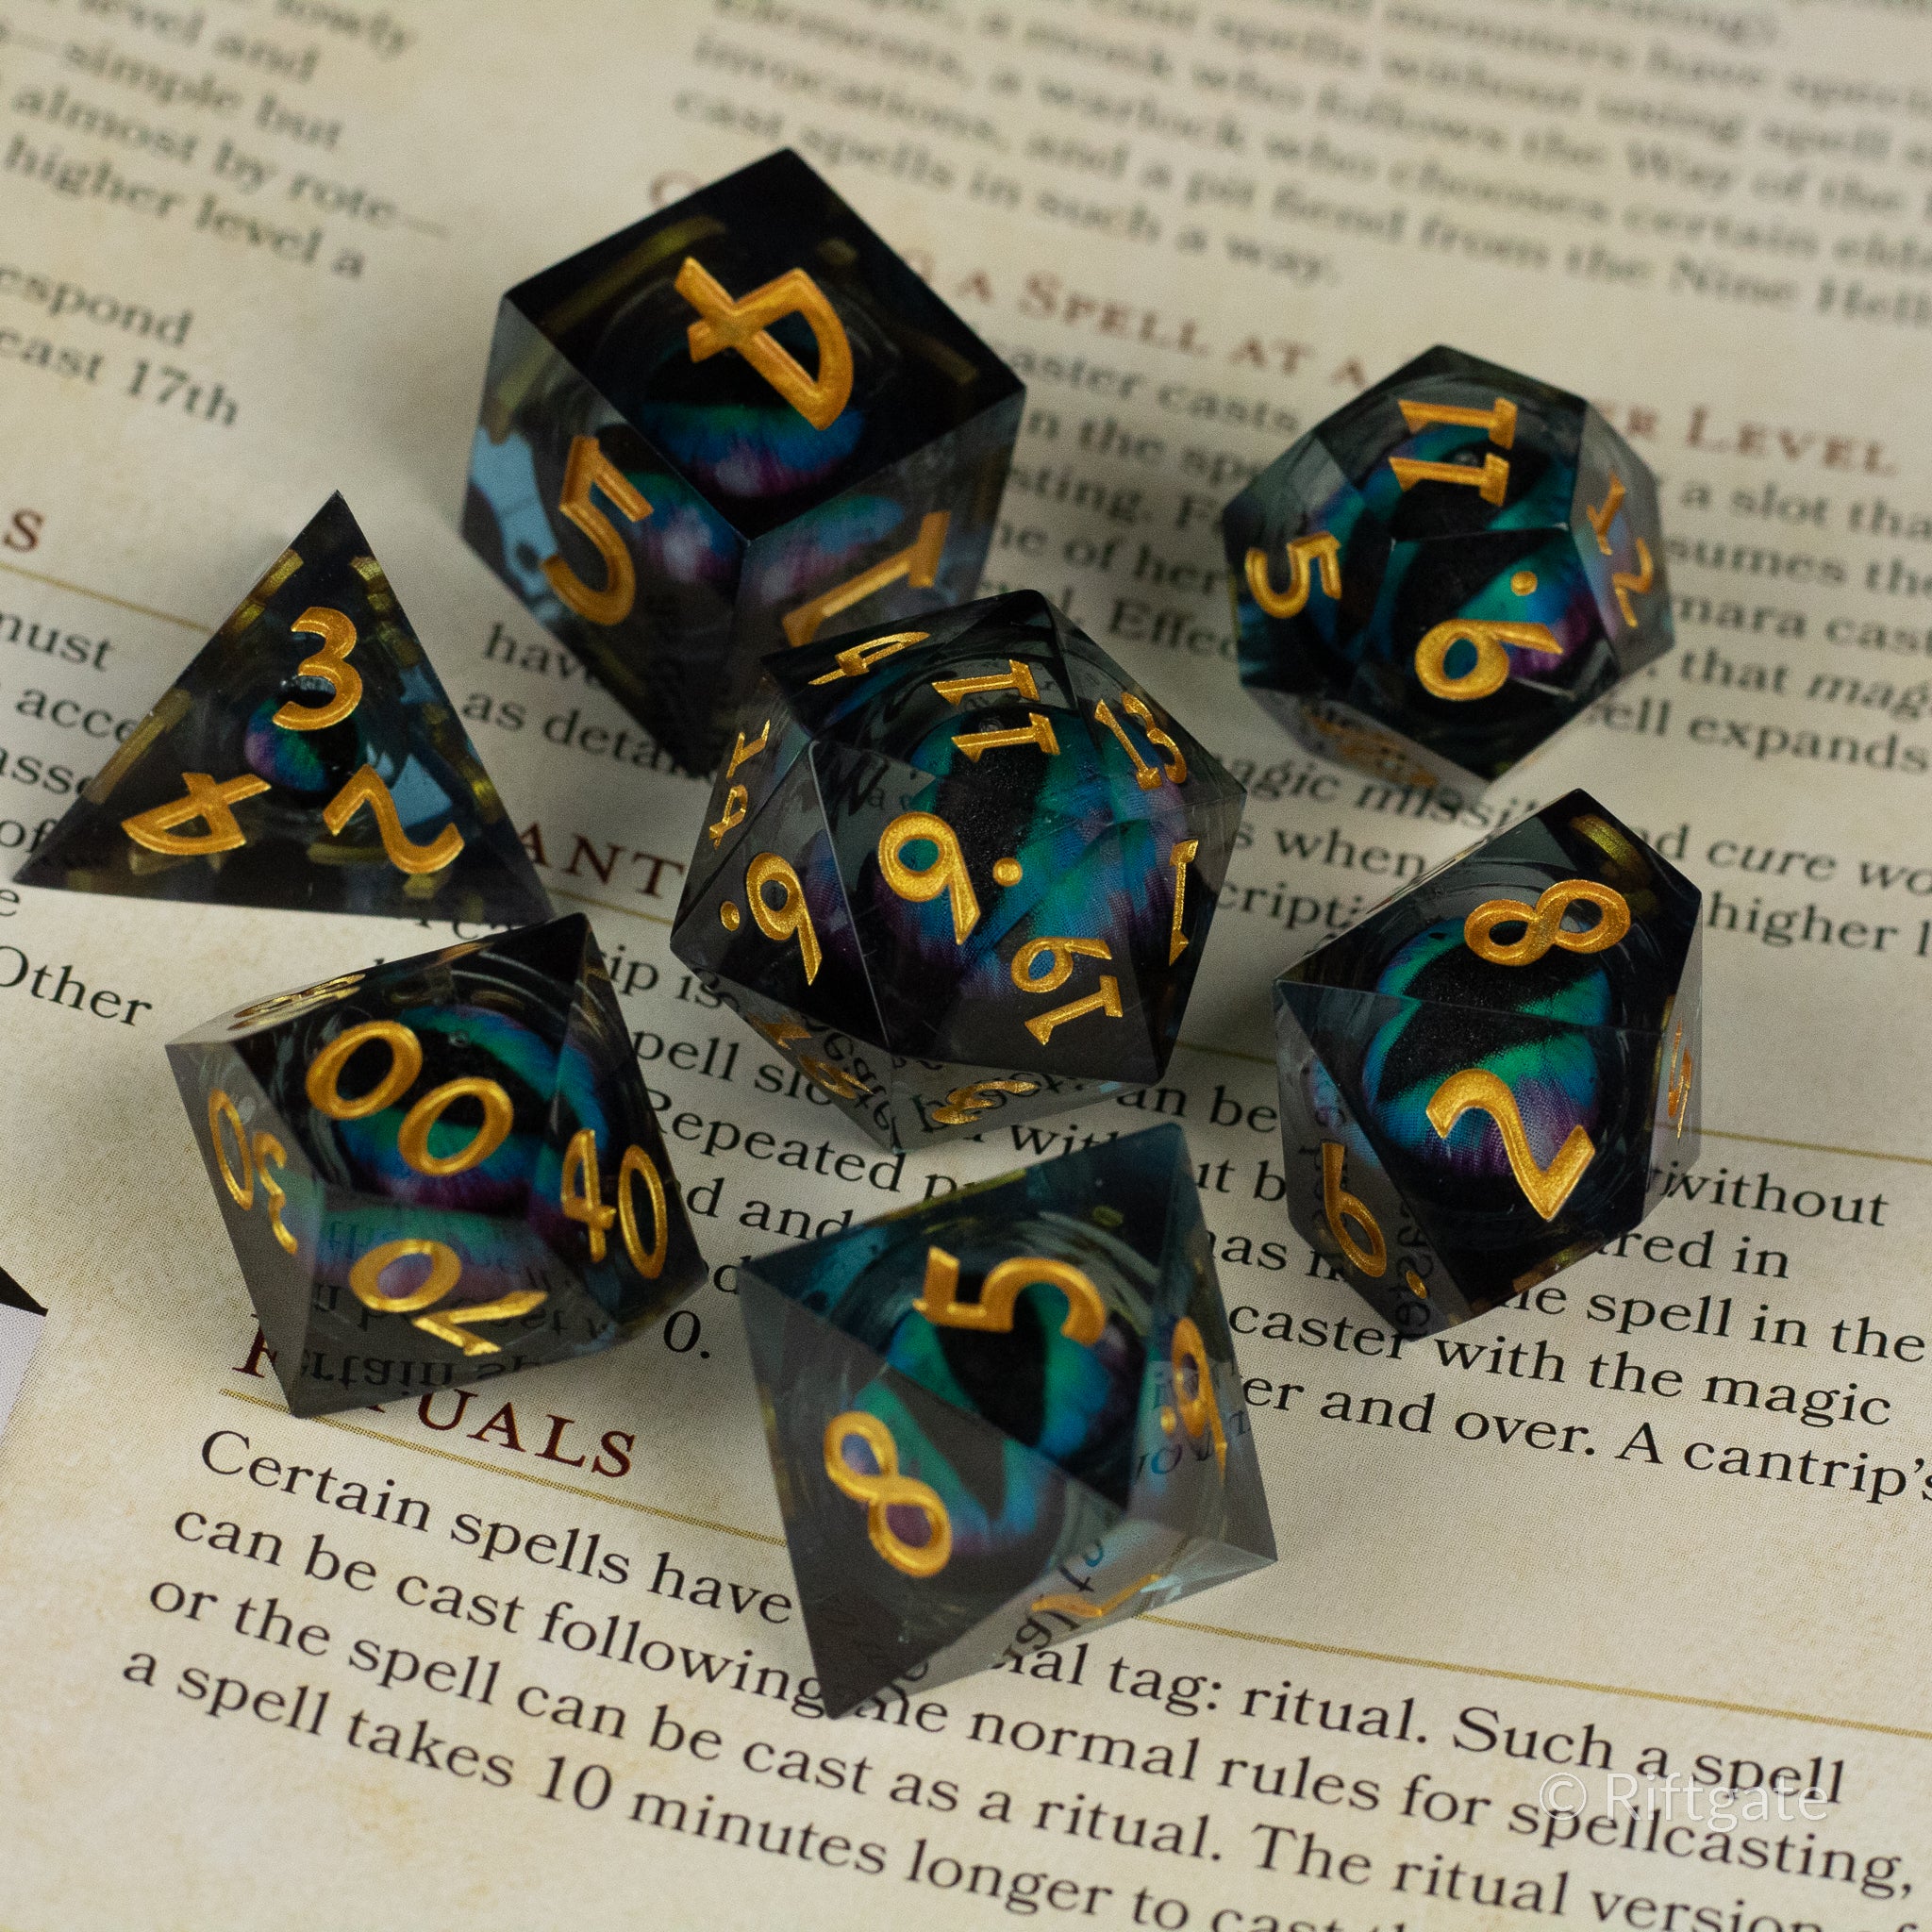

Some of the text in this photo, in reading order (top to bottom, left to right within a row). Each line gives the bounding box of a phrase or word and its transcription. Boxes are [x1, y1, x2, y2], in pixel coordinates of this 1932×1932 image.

[127, 358, 239, 427] 17th
[673, 255, 855, 432] 4
[1011, 351, 1149, 402] aster
[1388, 395, 1518, 508] 11
[538, 434, 655, 626] 5
[1665, 536, 1846, 585] sumes
[1847, 498, 1932, 542] tha
[780, 509, 952, 649] 1
[1243, 530, 1342, 619] 5
[272, 606, 363, 731] 3
[931, 658, 1061, 763] 11
[1805, 671, 1932, 724] mag
[1093, 691, 1188, 791] 13
[1236, 758, 1340, 804] agic
[121, 771, 273, 856] 4
[323, 763, 466, 874] 2
[1463, 878, 1632, 967] 8
[1706, 889, 1899, 951] higher
[0, 945, 153, 1028] Other
[305, 1018, 515, 1177] 00
[634, 1027, 739, 1083] pell
[1209, 1085, 1278, 1132] be
[1425, 1068, 1596, 1221] 2
[559, 1127, 669, 1280] 40
[911, 1246, 1107, 1347] 5
[1221, 1234, 1289, 1270] as
[1731, 1236, 1790, 1281] in
[1227, 1303, 1892, 1431] caster with the magic
[1585, 1295, 1732, 1340] spell
[1751, 1303, 1809, 1350] in
[1830, 1316, 1927, 1363] the
[1241, 1374, 1305, 1413] er
[1319, 1391, 1438, 1435] and
[1453, 1409, 1598, 1458] over.
[1614, 1422, 1665, 1466] A
[200, 1429, 794, 1625] Certain spells have
[823, 1410, 954, 1578] 8
[174, 1509, 827, 1721] can be cast following
[148, 1580, 221, 1623] or
[232, 1596, 333, 1657] the
[346, 1636, 503, 1706] spell
[516, 1682, 627, 1740] can
[647, 1704, 723, 1762] be
[741, 1740, 875, 1795] cast
[888, 1770, 961, 1814] as
[977, 1789, 1013, 1824] a
[1032, 1791, 1224, 1863] ritual.
[1249, 1821, 1374, 1888] The
[1391, 1852, 1573, 1916] ritual
[1108, 1654, 1224, 1719] tag:
[1238, 1681, 1429, 1745] ritual.
[1451, 1705, 1617, 1772] Such
[1634, 1743, 1674, 1781] a
[1691, 1752, 1846, 1806] spell
[122, 1651, 1191, 1930] a spell takes 10 minutes longer to
[965, 1707, 1201, 1783] normal
[1220, 1752, 1383, 1814] rules
[1399, 1772, 1492, 1828] for
[1507, 1797, 1914, 1902] spellcasting,
